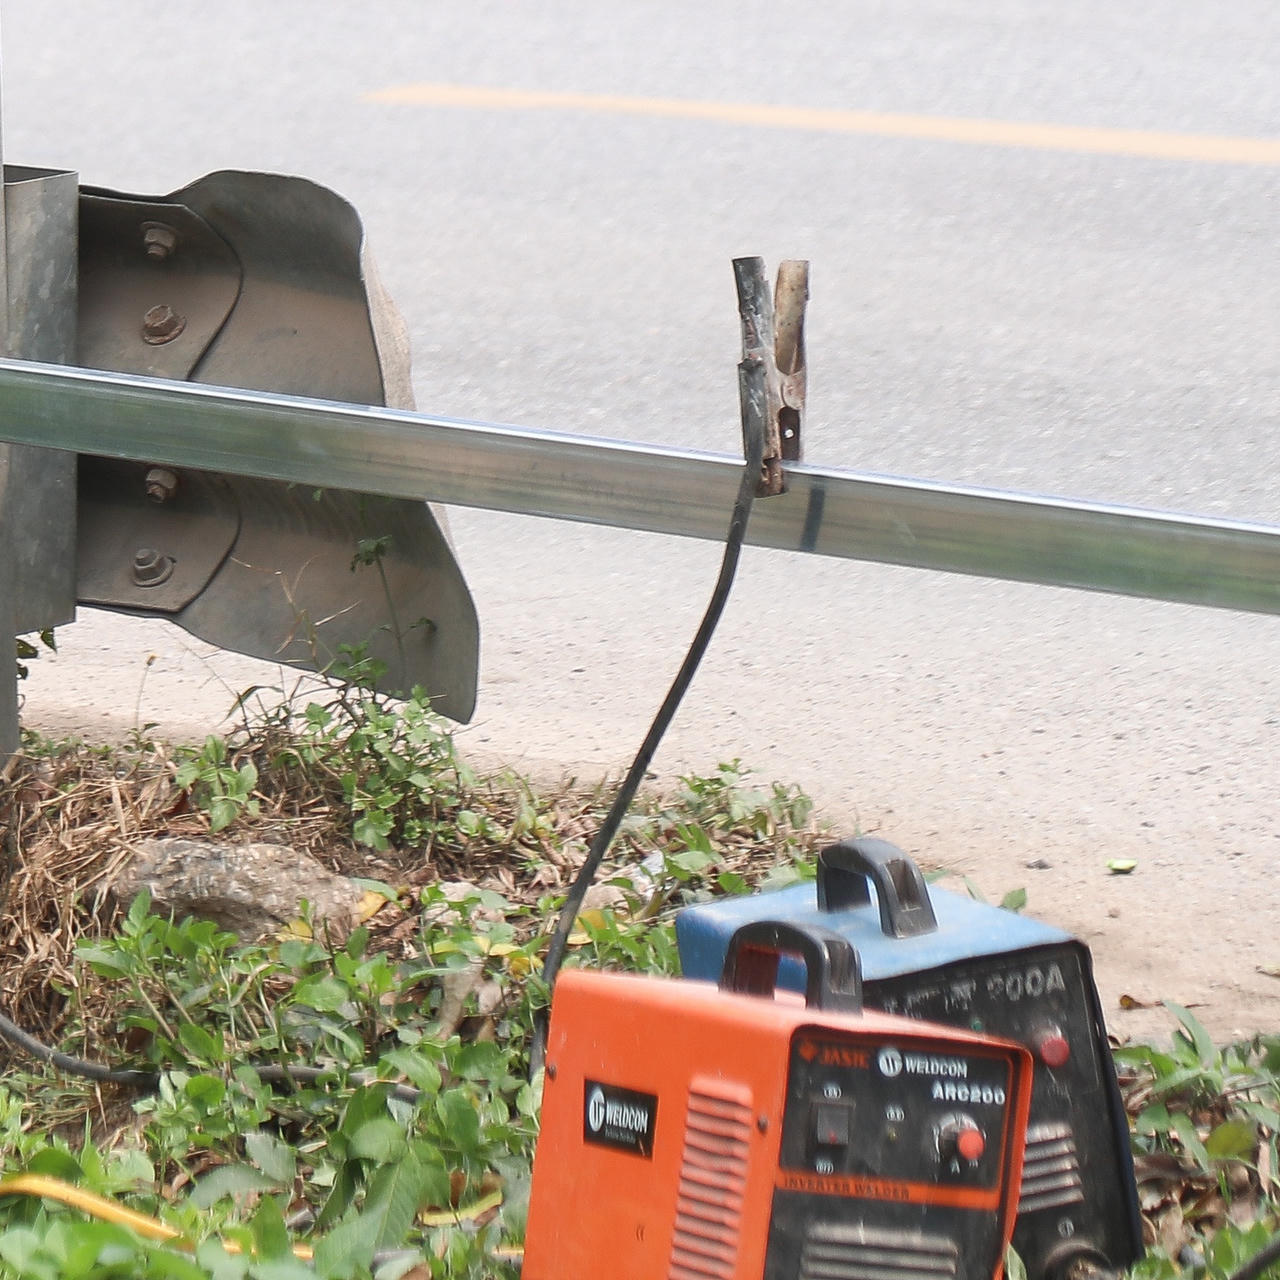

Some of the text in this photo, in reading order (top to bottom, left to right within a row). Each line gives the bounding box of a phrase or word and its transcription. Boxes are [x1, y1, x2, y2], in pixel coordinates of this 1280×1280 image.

[904, 1054, 968, 1079] WELDCOM
[931, 1079, 1007, 1106] ARC200
[605, 1099, 649, 1134] WELDCOM
